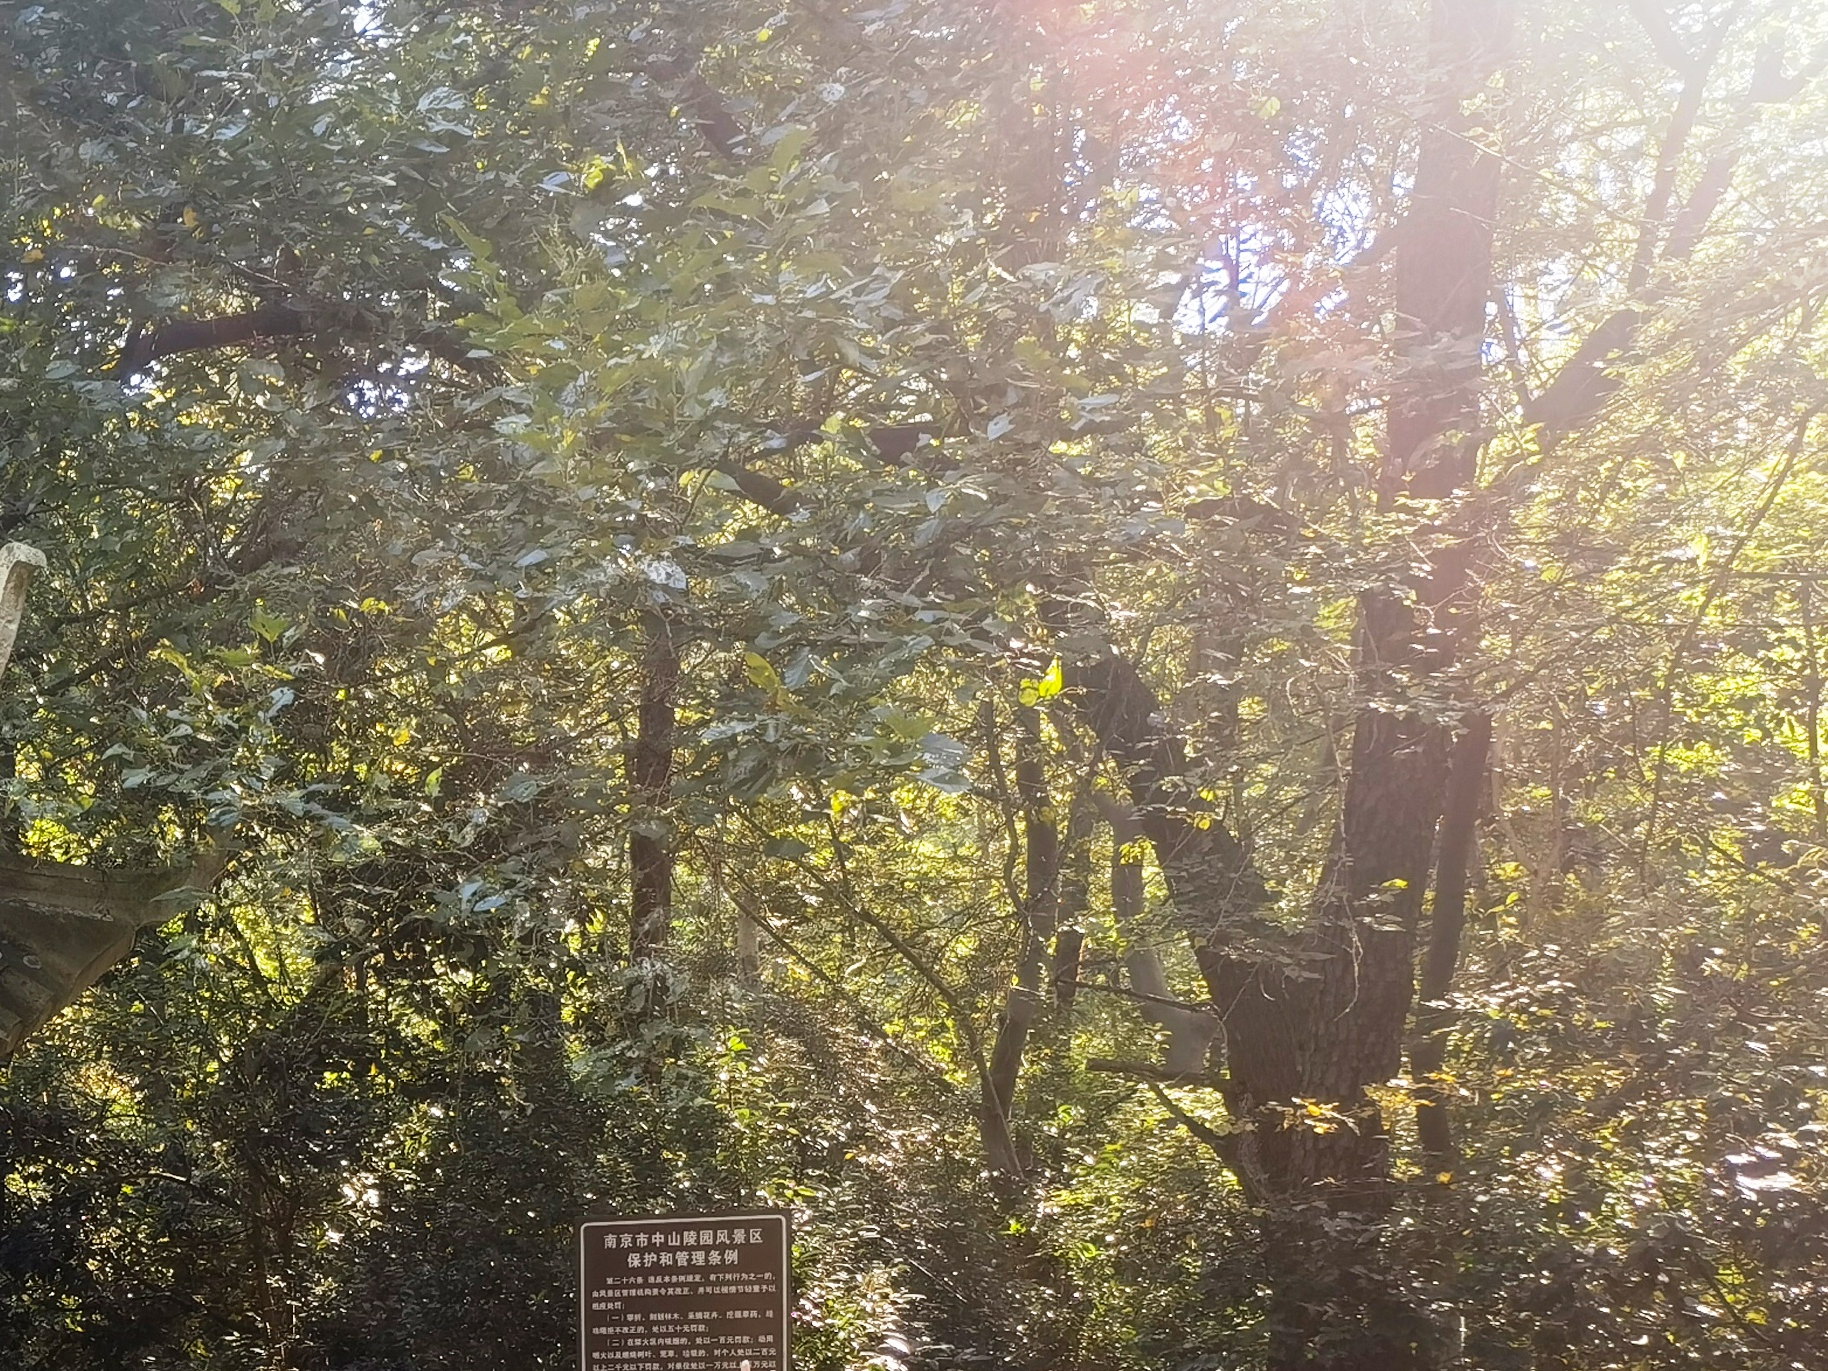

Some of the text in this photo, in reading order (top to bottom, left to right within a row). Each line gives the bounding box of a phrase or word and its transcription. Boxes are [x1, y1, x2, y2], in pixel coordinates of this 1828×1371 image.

[603, 1228, 764, 1250] 南京市中山陵园风景区
[626, 1249, 740, 1269] 保护和管理条例
